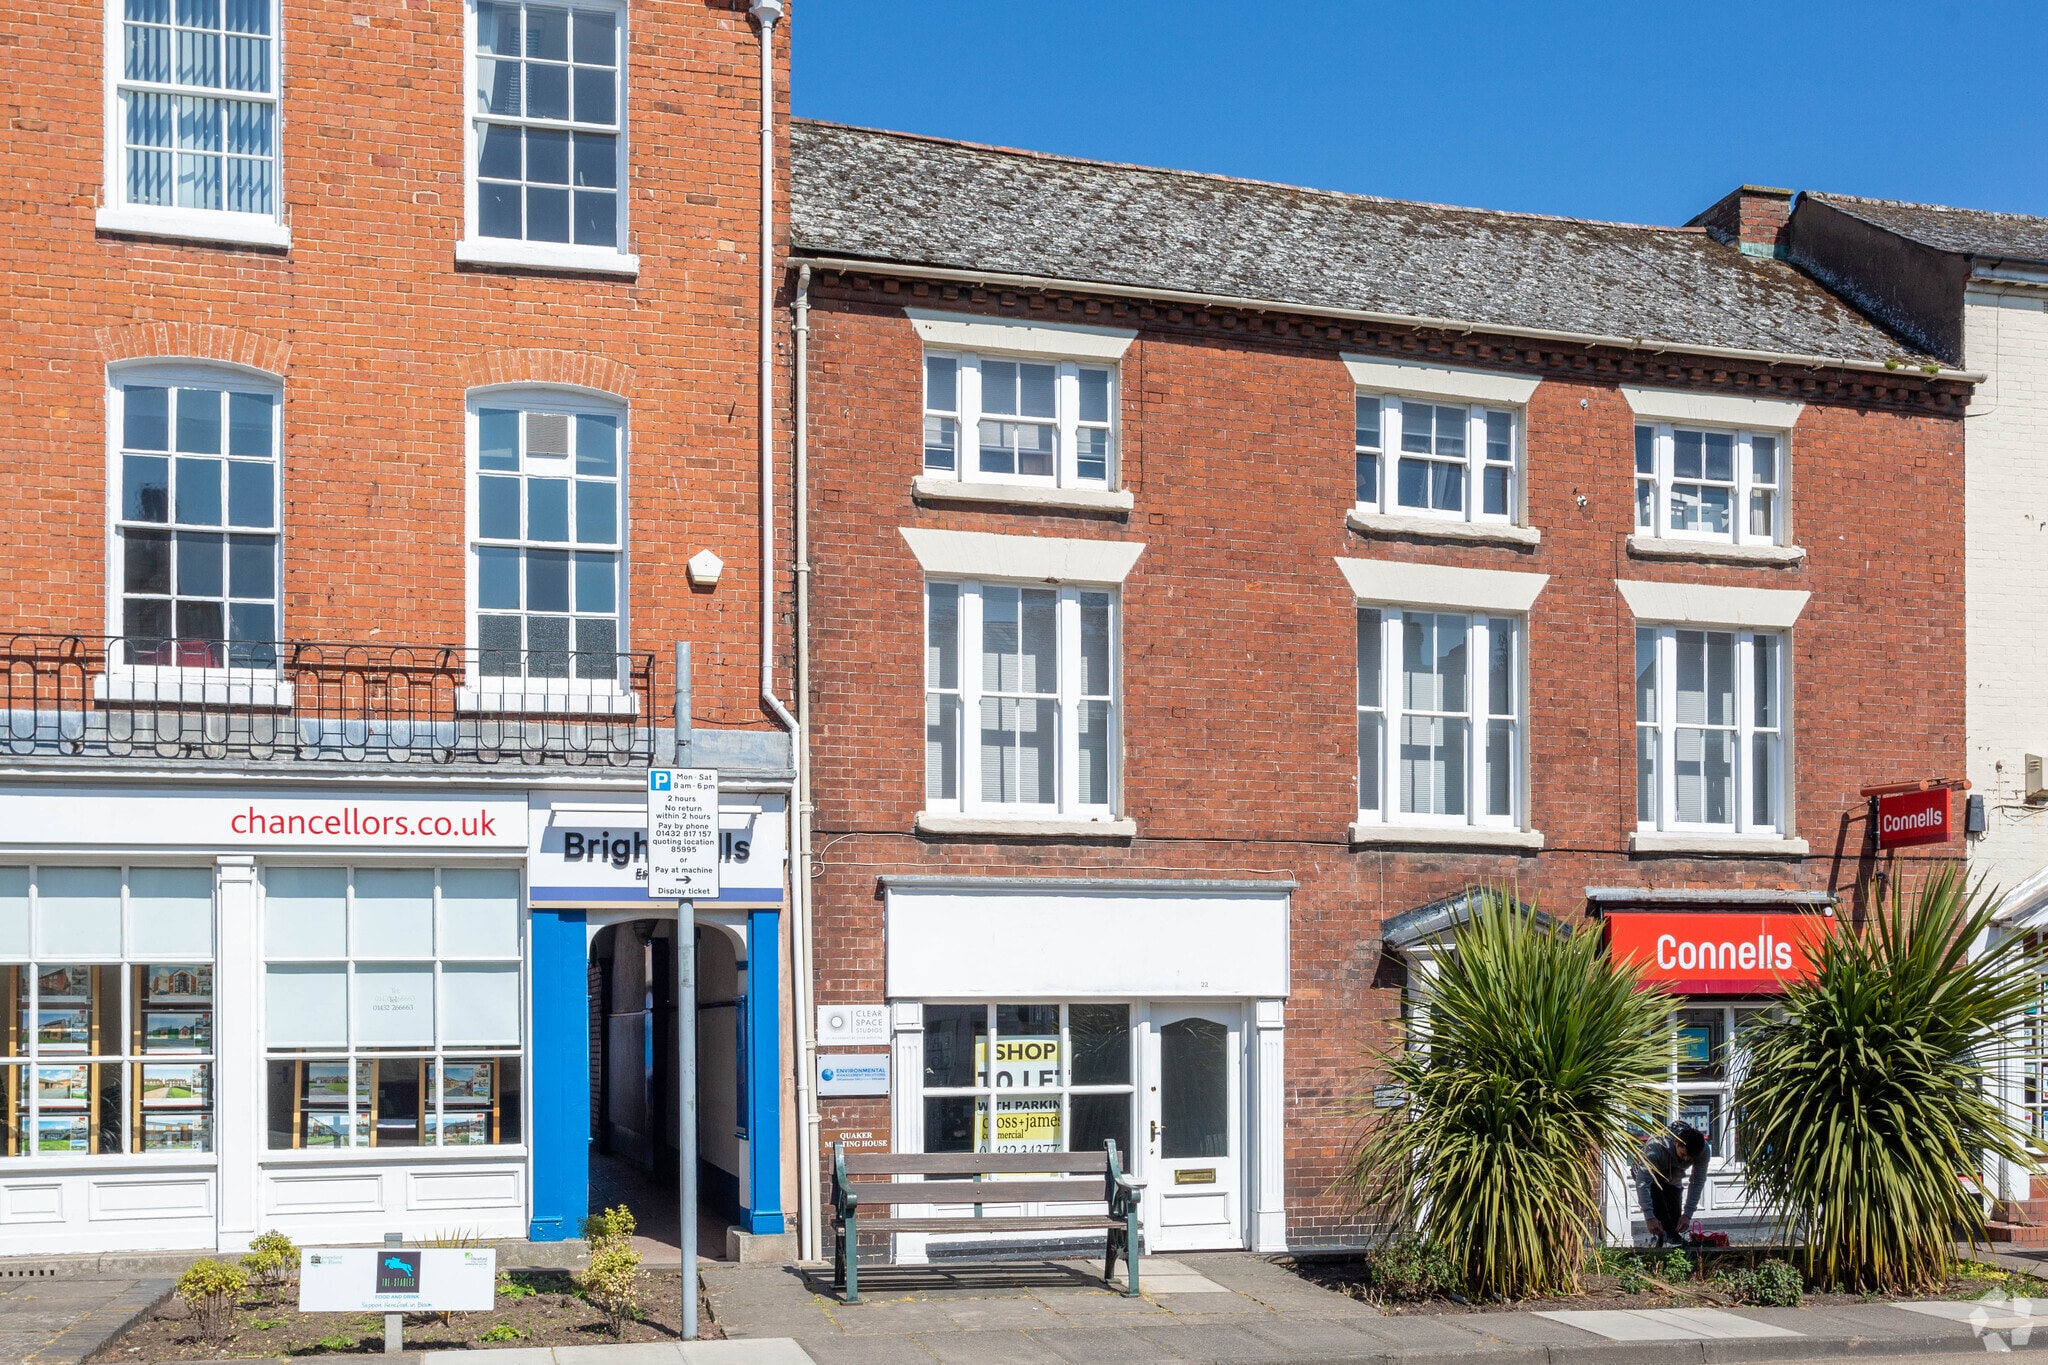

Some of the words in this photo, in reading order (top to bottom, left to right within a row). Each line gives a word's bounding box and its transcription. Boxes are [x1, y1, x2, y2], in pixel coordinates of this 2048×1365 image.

[655, 773, 668, 789] P
[677, 773, 693, 781] Mon
[699, 773, 712, 781] Sat
[231, 806, 496, 836] chancellors.co.uk
[1883, 808, 1943, 832] Connells
[658, 822, 672, 830] Pay
[674, 822, 683, 830] by
[686, 822, 709, 830] phone
[564, 831, 750, 865] Brighlls
[655, 866, 669, 874] Pay
[1657, 933, 1792, 970] Connells
[856, 1010, 882, 1018] CLEAR
[856, 1018, 882, 1026] SPACE
[997, 1043, 1056, 1060] SHOP
[978, 1101, 1011, 1111] WTH
[1015, 1100, 1070, 1110] PARKIN
[982, 1113, 1061, 1132] coss+jame
[840, 1132, 872, 1140] QUAKER
[982, 1129, 1024, 1140] comercial
[824, 1140, 861, 1148] MTING
[979, 1144, 1016, 1153] 0432
